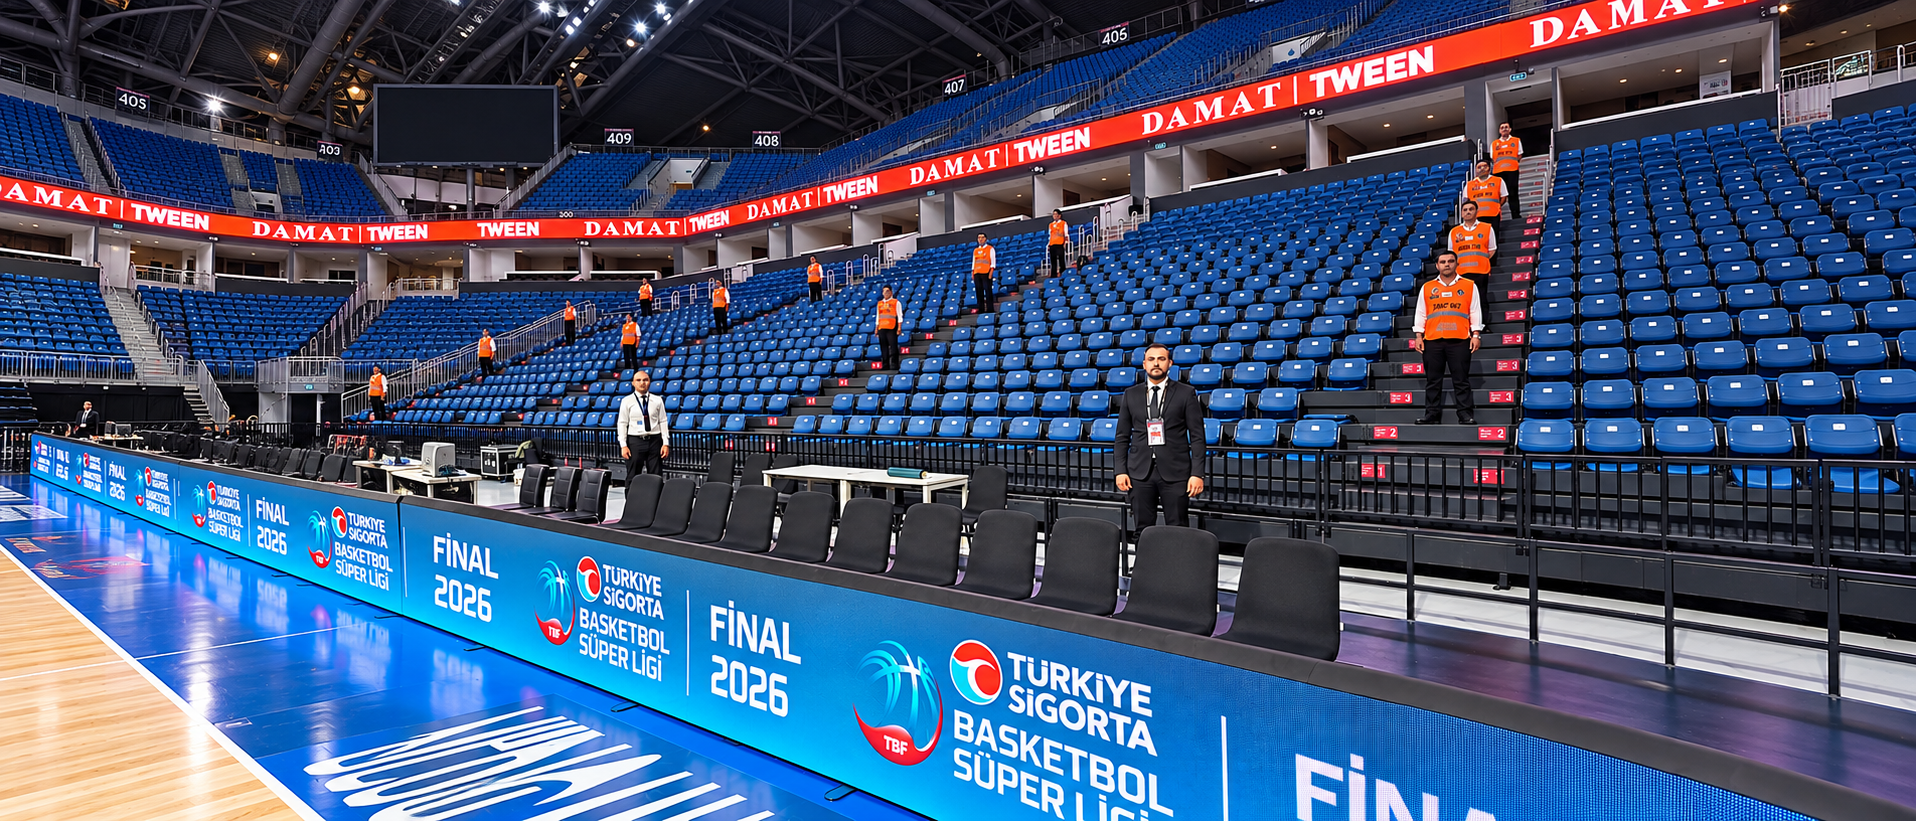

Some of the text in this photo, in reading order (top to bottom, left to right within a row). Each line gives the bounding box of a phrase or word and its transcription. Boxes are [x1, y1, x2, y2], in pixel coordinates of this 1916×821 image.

[1529, 0, 1734, 48] DAMA
[944, 79, 965, 95] 407
[1142, 45, 1434, 135] DAMAT TWEEN
[606, 132, 632, 145] 409
[754, 134, 779, 147] 408
[909, 127, 1091, 185] DAMAT TWEEN
[0, 182, 210, 230] AMAT TWEEN
[747, 175, 878, 220] DAMAT TWEEN
[252, 221, 428, 241] DAMAT TWEEN
[477, 222, 540, 237] TWEEN
[584, 210, 730, 236] DAMAT TWEEN
[256, 497, 290, 526] FİNAL
[257, 526, 287, 555] 2026
[334, 541, 393, 572] BASKETBOL
[433, 532, 498, 579] FİNAL
[335, 559, 389, 591] SÜPER LİGİ
[603, 564, 662, 597] TÜRKİYE
[434, 574, 493, 623] 2026
[579, 606, 670, 655] BASKETBOL
[710, 600, 801, 664] FİNAL
[579, 633, 662, 682] SÜPER LİGİ
[710, 654, 789, 718] 2026
[1007, 651, 1152, 718] TÜRKİYE
[883, 734, 908, 756] TBF
[953, 709, 1174, 817] BASKETBOL
[953, 748, 1065, 820] SÜPER
